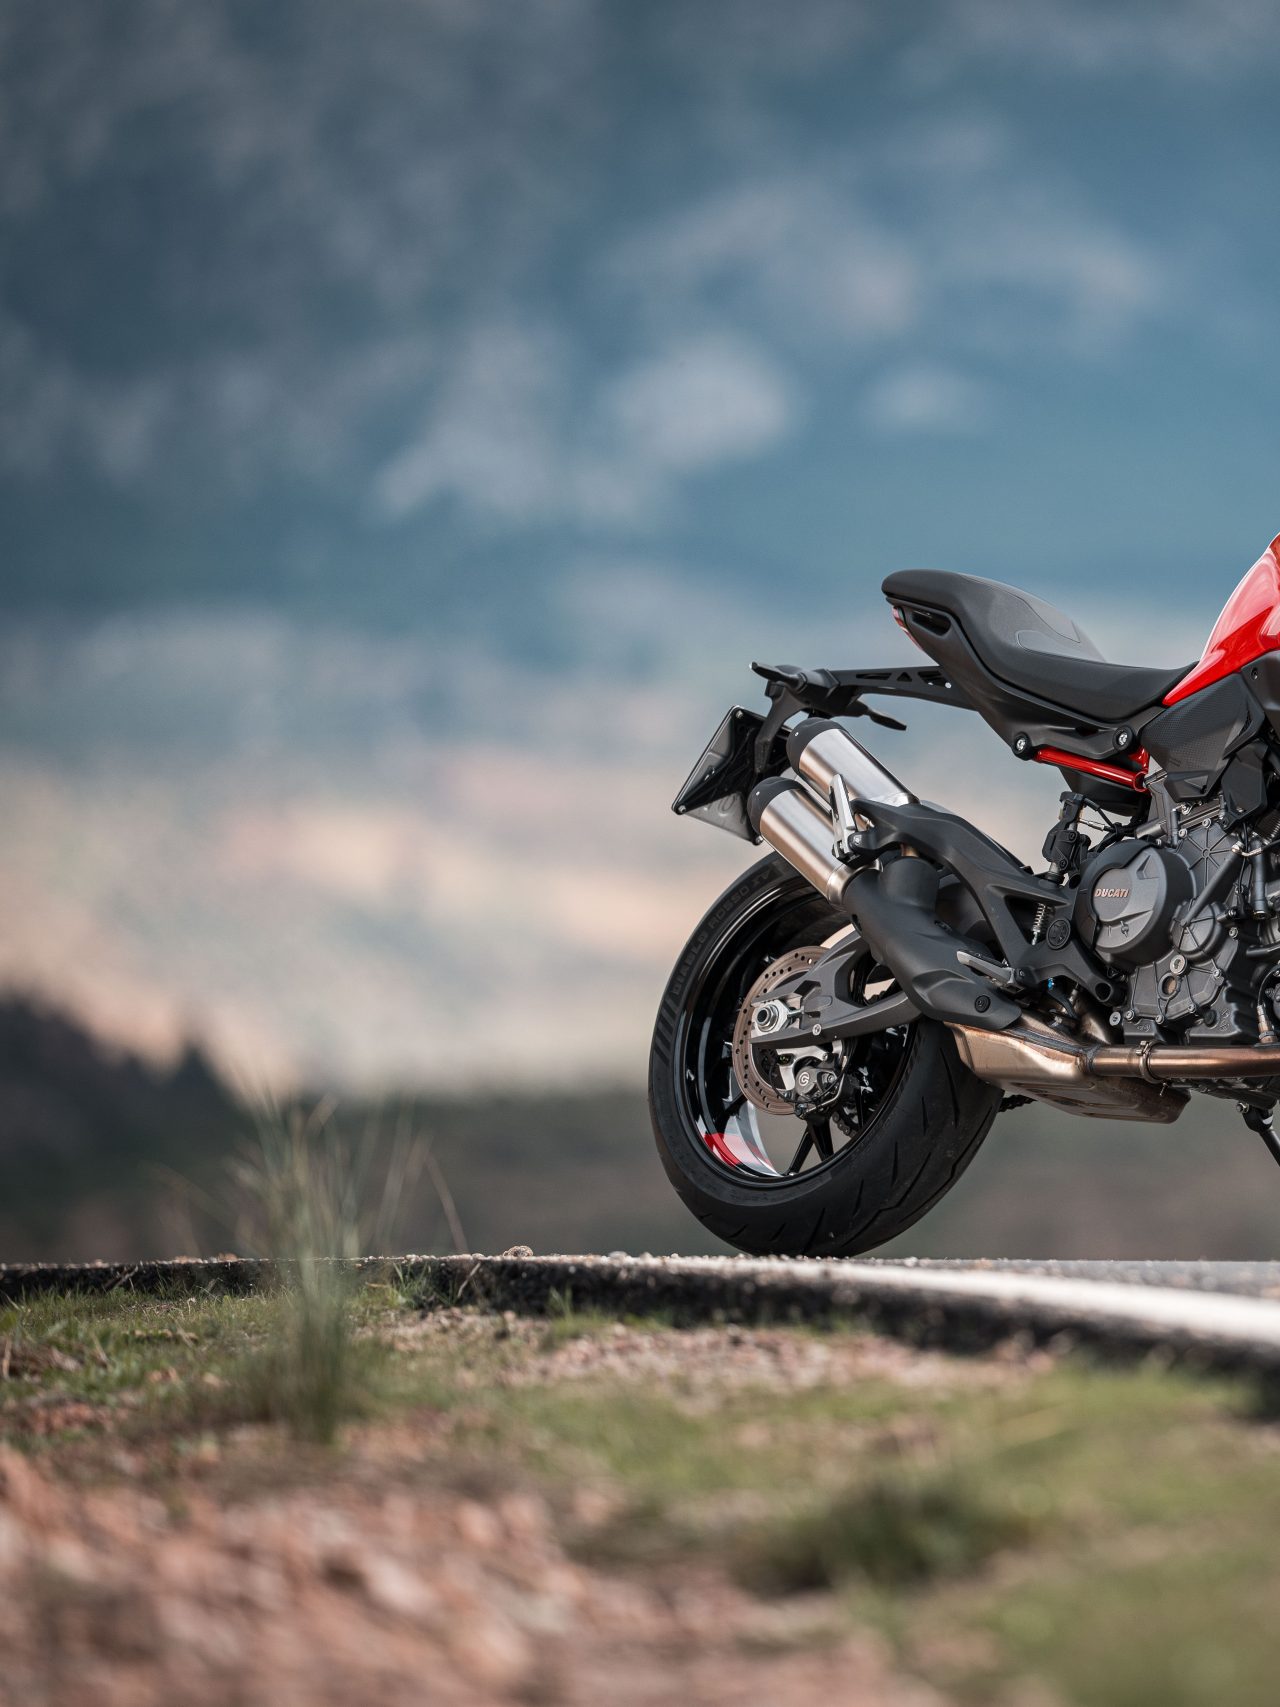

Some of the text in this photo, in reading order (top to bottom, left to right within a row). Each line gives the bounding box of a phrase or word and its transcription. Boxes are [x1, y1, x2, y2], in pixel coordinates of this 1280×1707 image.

[1094, 888, 1129, 898] DUCATI
[672, 932, 708, 995] DIABLO
[709, 886, 750, 929] ROSSO
